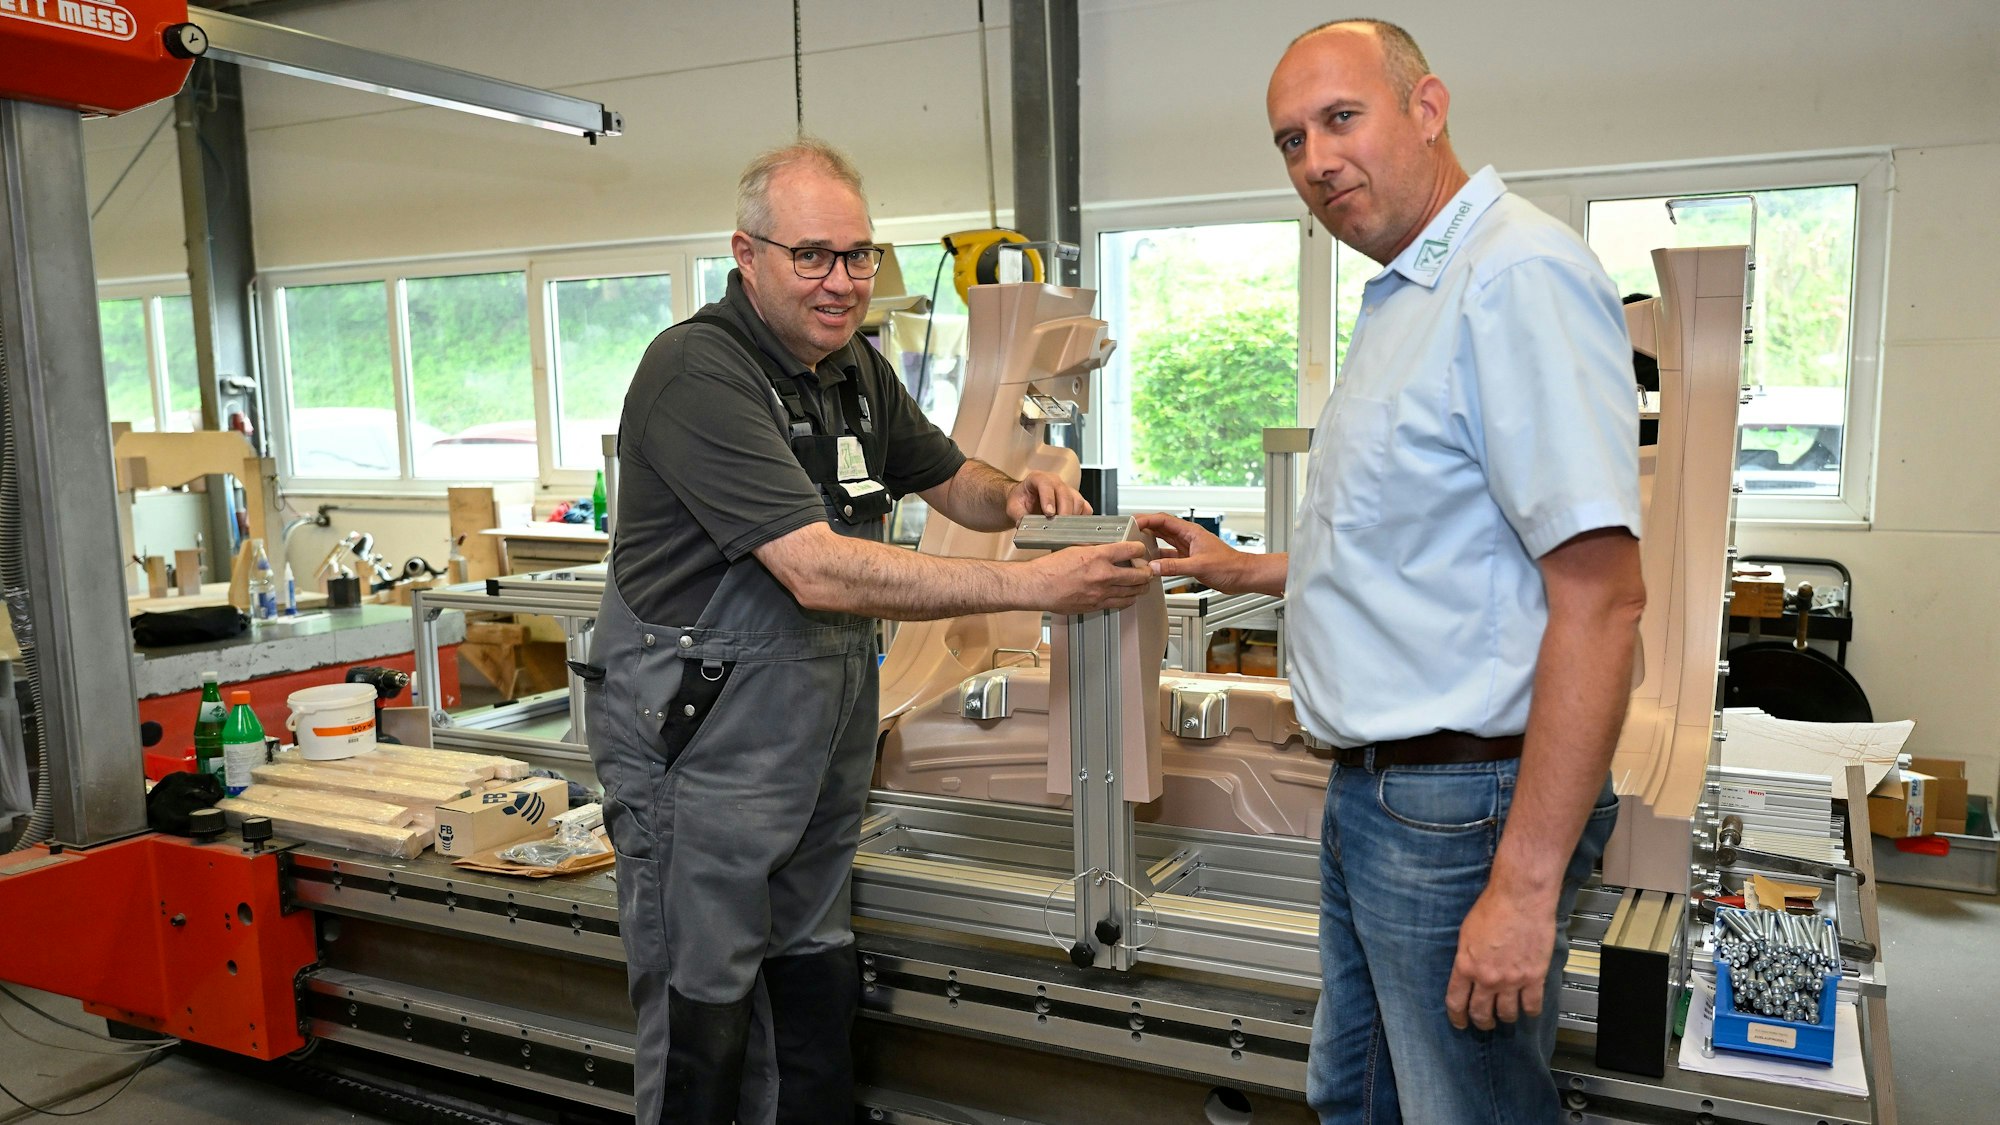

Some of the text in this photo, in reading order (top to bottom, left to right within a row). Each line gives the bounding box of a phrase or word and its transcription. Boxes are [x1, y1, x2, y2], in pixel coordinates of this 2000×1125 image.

[58, 0, 129, 35] MESS
[188, 32, 199, 44] Y
[440, 824, 453, 835] FB
